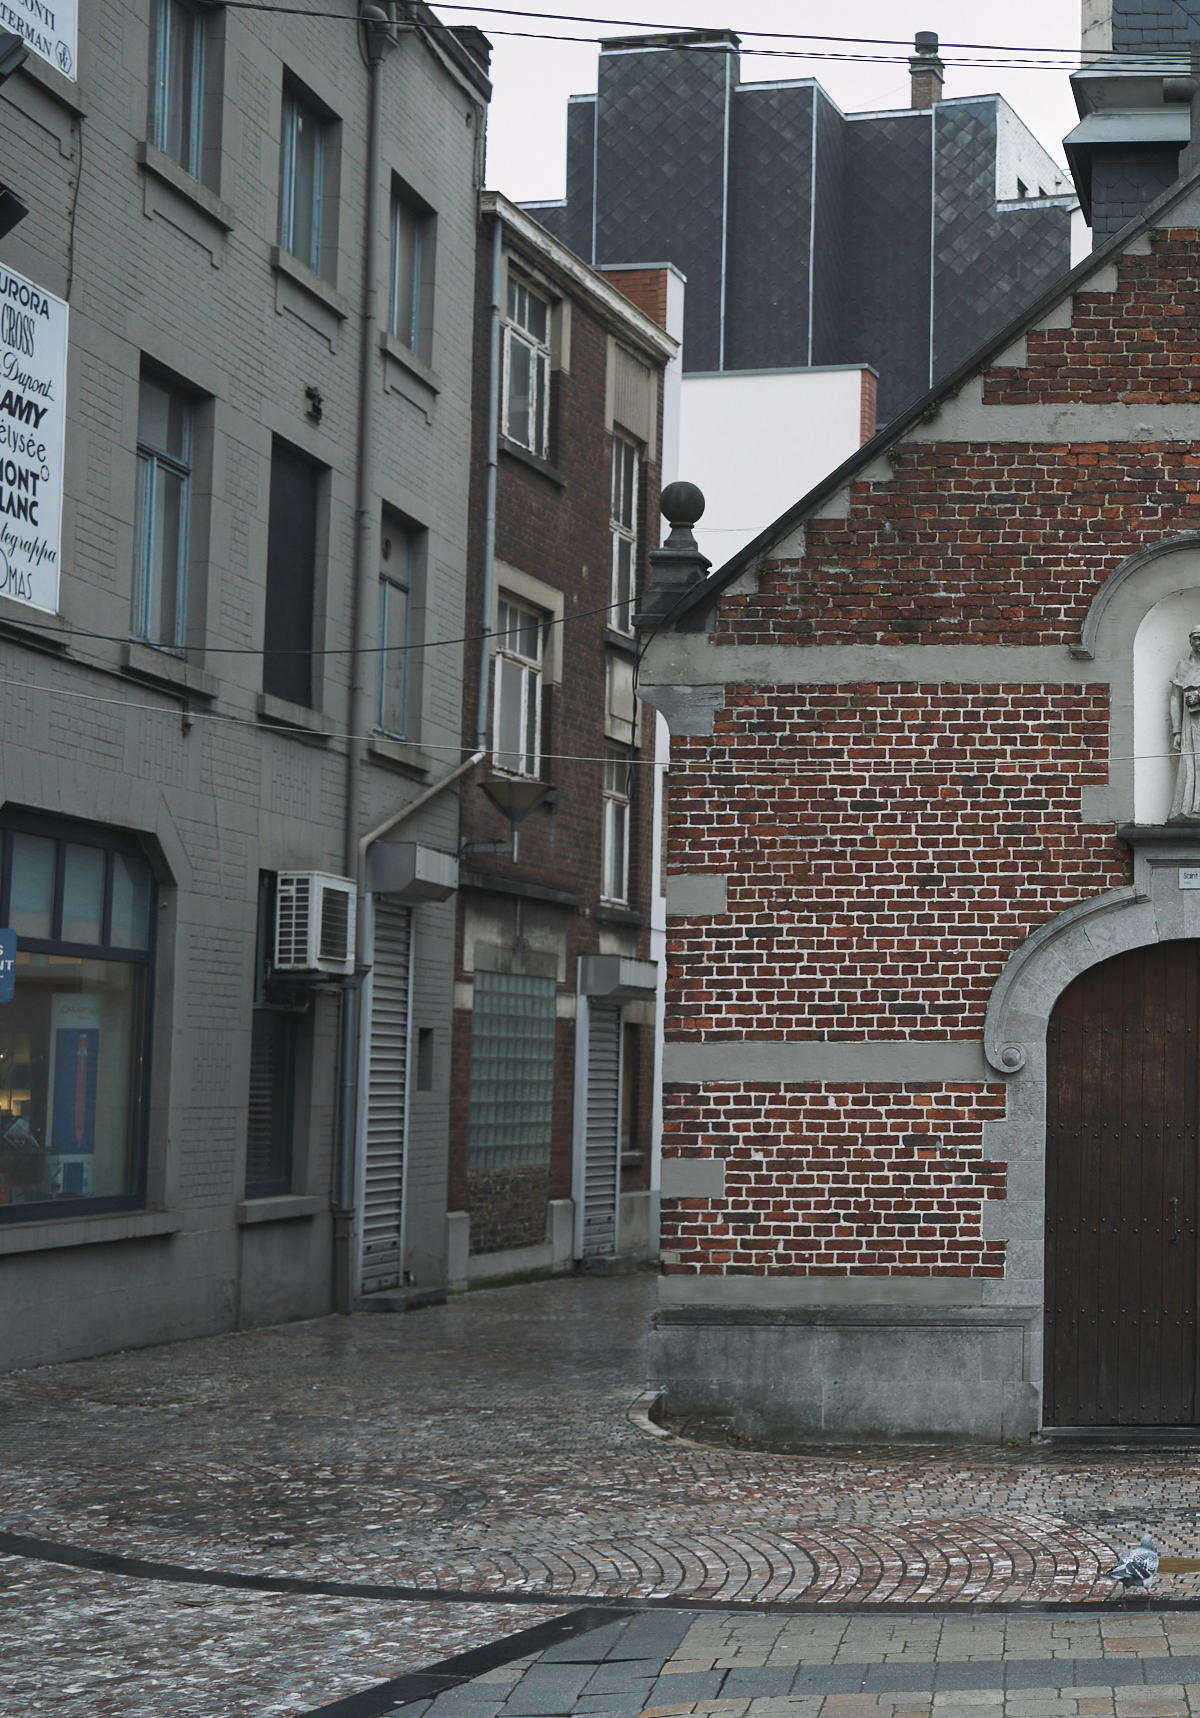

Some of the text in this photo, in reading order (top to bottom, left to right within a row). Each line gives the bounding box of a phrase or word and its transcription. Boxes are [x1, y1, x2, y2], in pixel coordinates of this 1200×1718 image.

[1, 302, 35, 358] CROSS
[3, 351, 55, 402] Dupont
[1183, 872, 1199, 880] Saint
